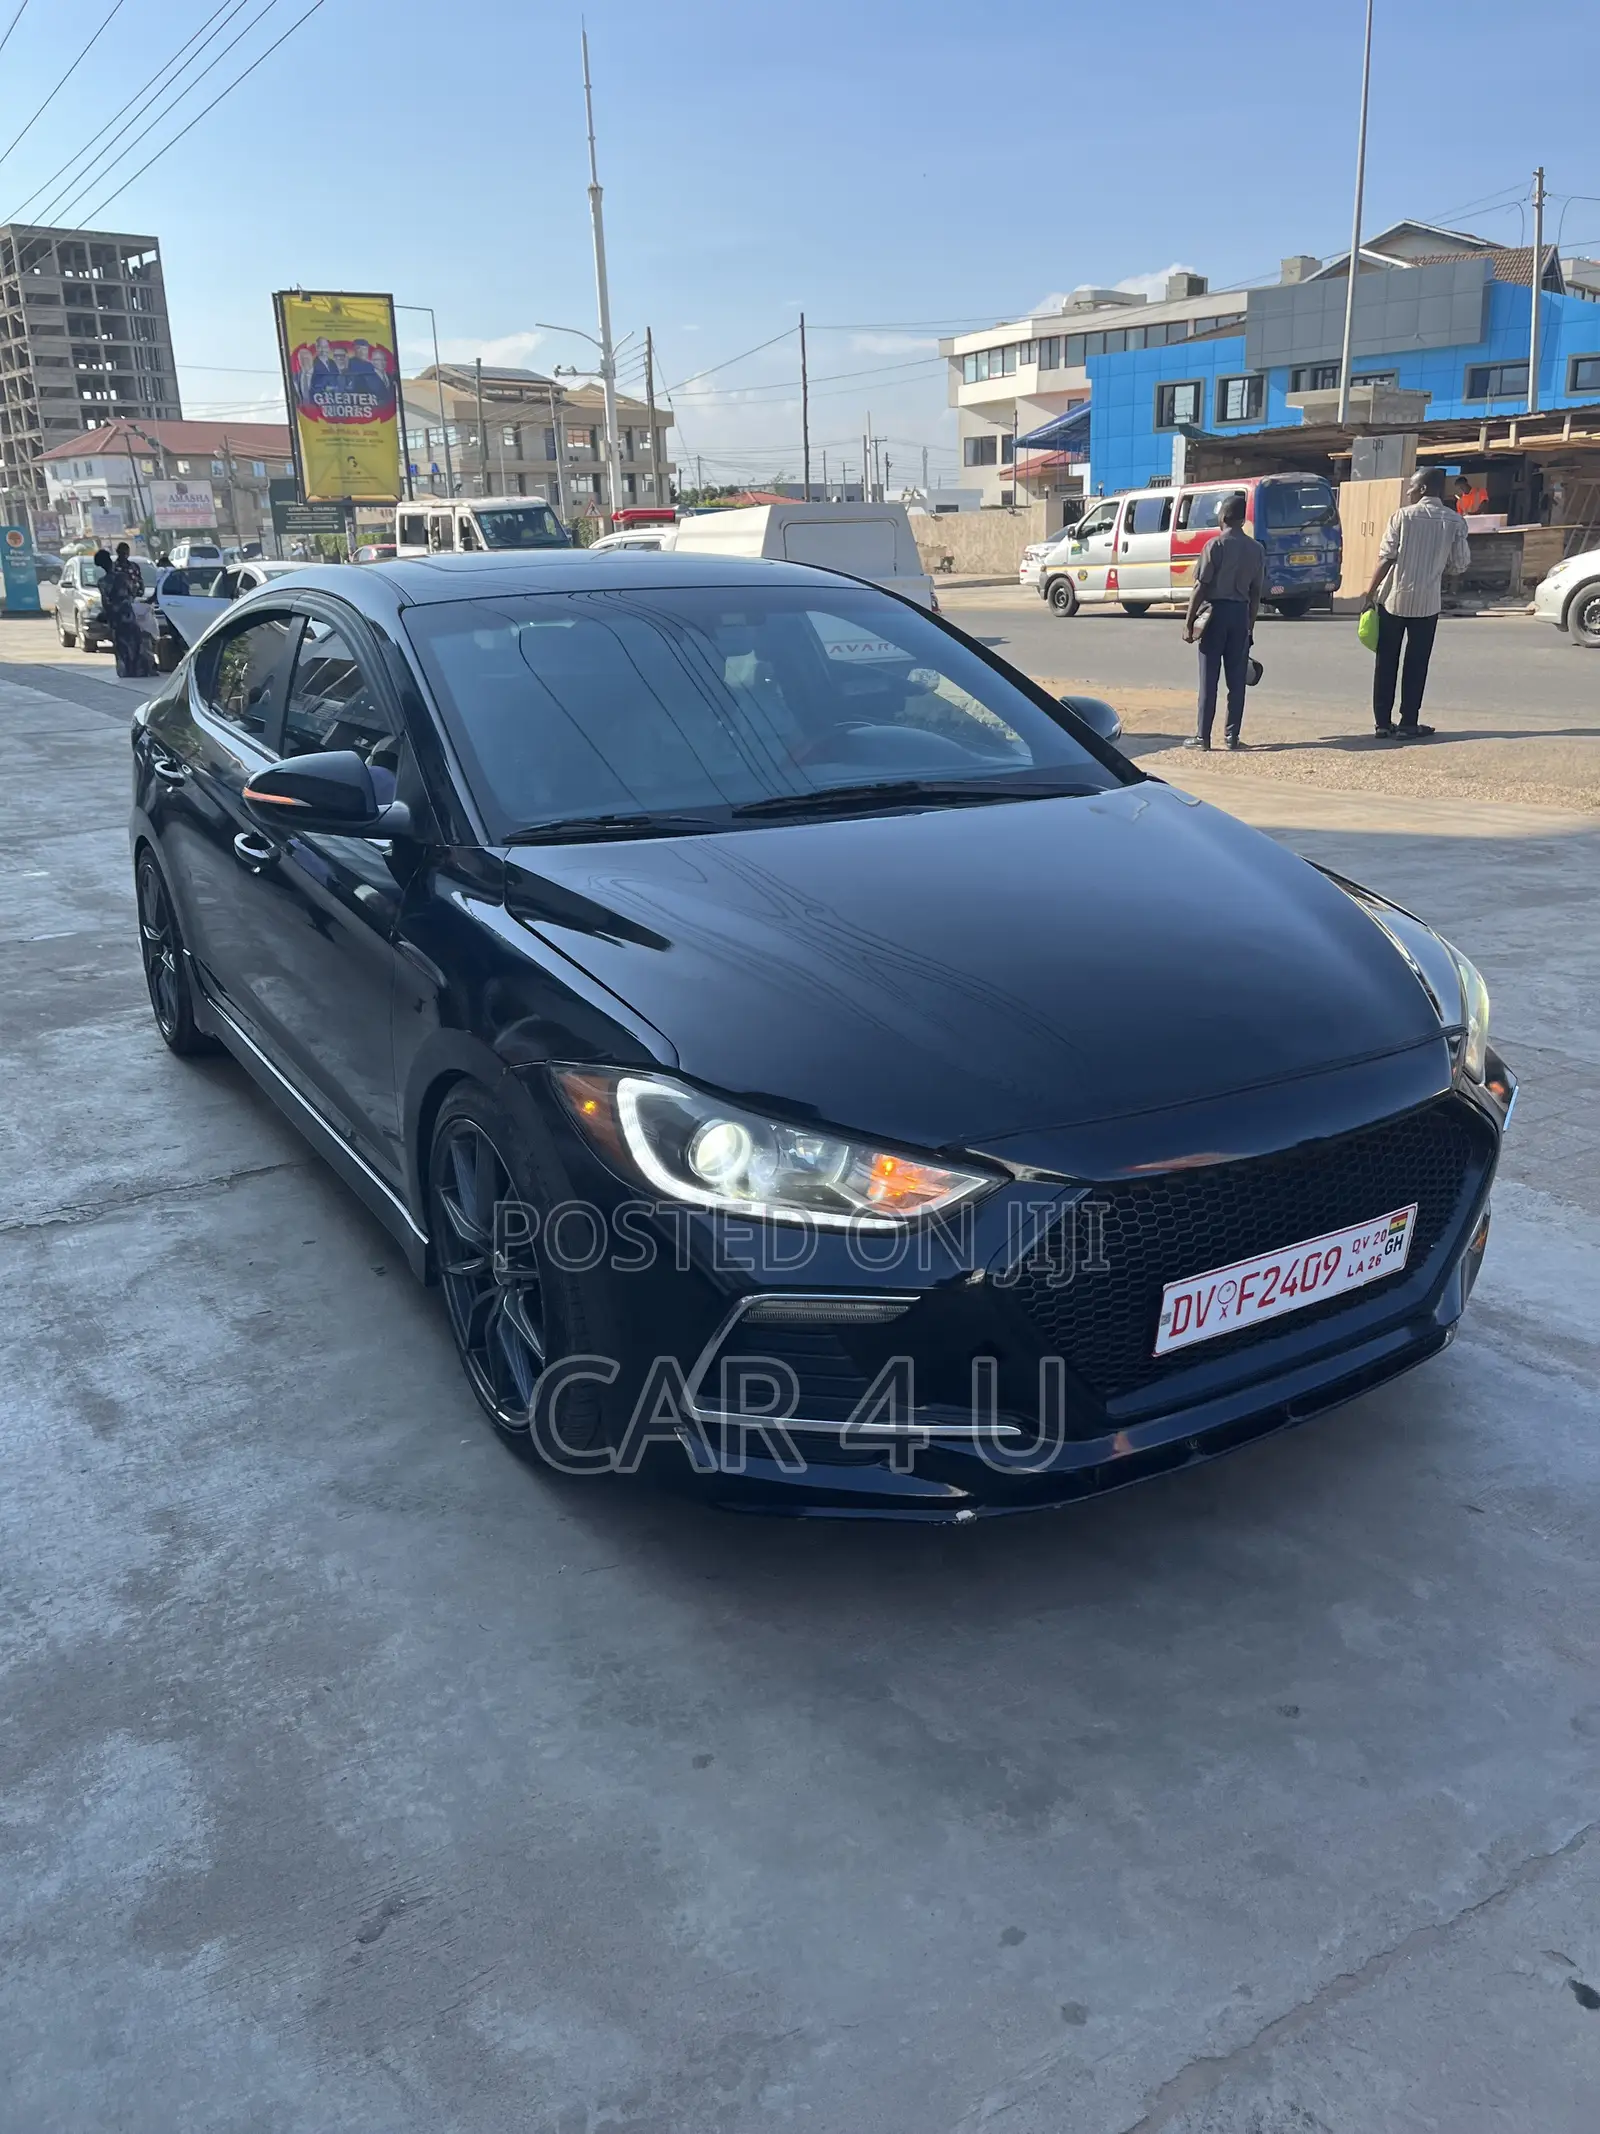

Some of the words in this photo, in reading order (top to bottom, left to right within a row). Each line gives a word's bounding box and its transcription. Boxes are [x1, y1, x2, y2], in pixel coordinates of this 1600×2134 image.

[313, 392, 378, 406] GREATER
[322, 406, 373, 418] WORKS
[1373, 1228, 1388, 1245] 20
[1384, 1234, 1404, 1256] GH
[1347, 1260, 1364, 1278] LA
[1368, 1253, 1383, 1270] 26
[1236, 1245, 1343, 1316] F2409
